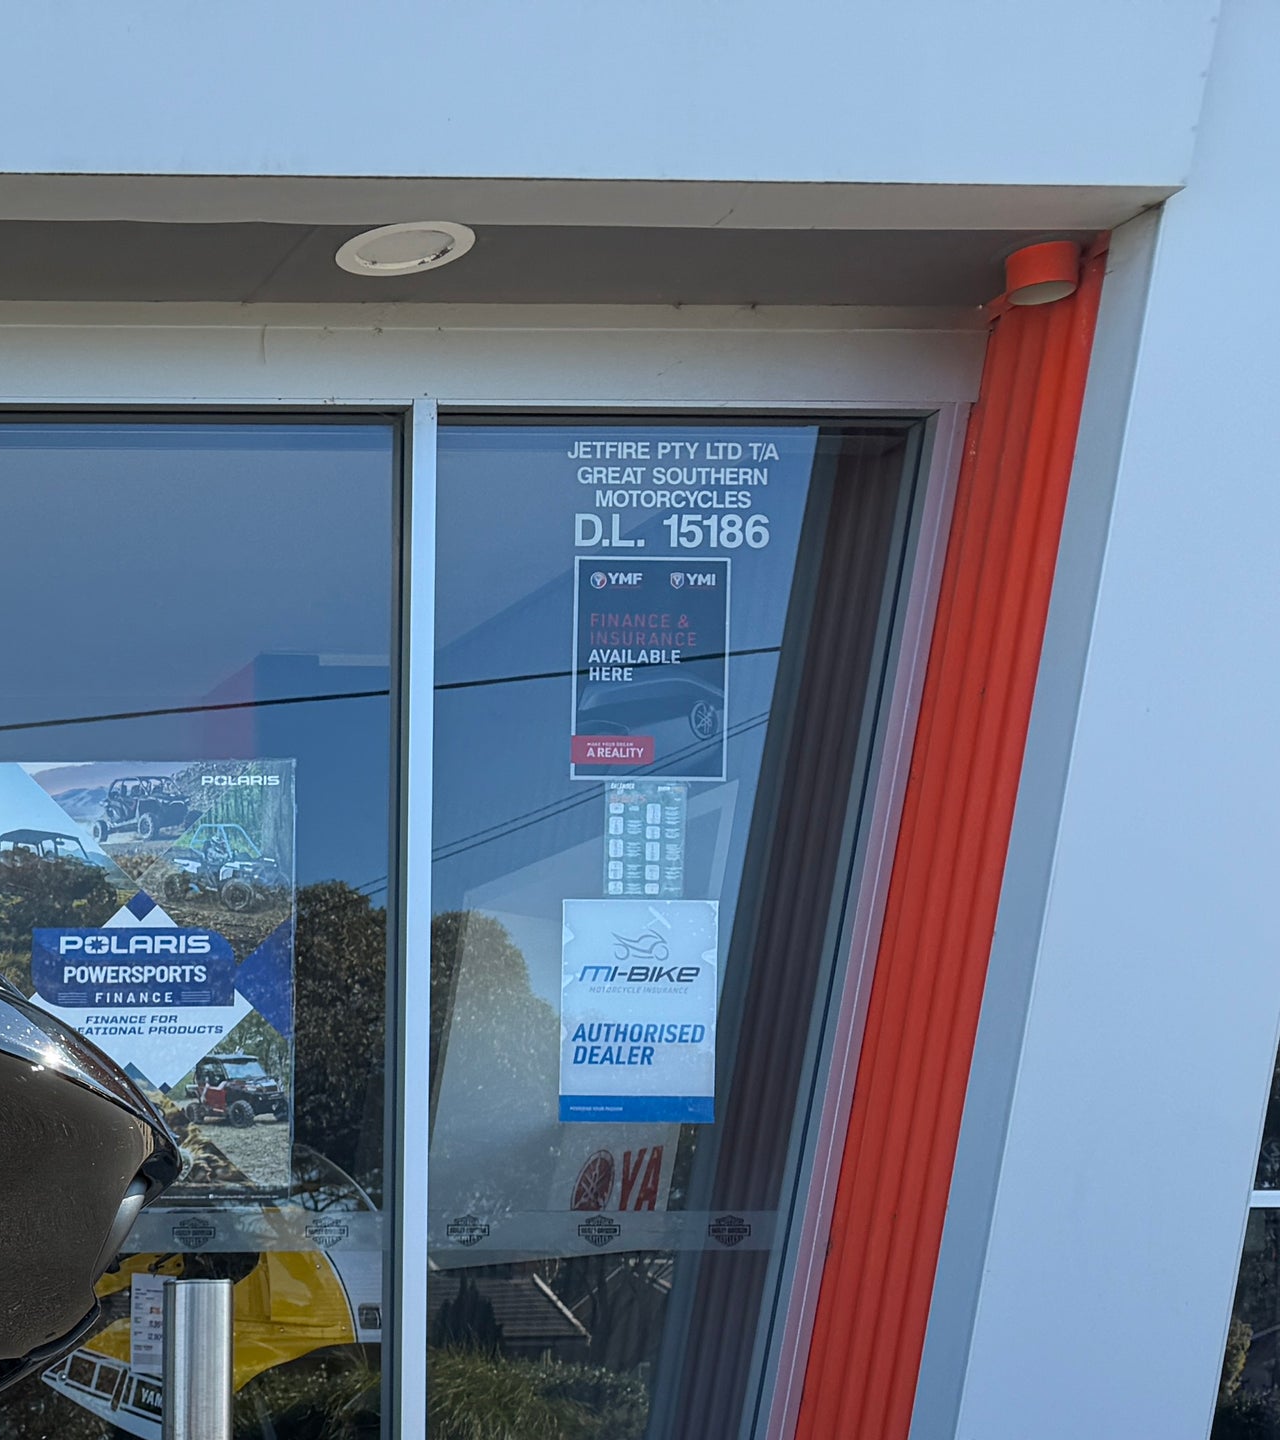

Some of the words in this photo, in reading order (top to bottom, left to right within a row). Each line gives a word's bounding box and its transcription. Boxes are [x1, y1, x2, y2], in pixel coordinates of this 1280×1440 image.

[567, 441, 650, 460] JETFIRE
[657, 442, 699, 460] PTY
[705, 442, 742, 460] LTD
[748, 443, 780, 463] T/A
[577, 467, 646, 484] GREAT
[652, 467, 768, 486] SOUTHERN
[595, 490, 752, 509] MOTORCYCLES
[574, 513, 645, 548] D.L.
[663, 514, 770, 549] 15186
[607, 572, 643, 585] YMF
[686, 573, 716, 586] YMI
[590, 613, 671, 629] FINANCE
[678, 614, 689, 629] &
[590, 632, 697, 647] INSURANCE
[588, 649, 681, 664] AVAILABLE
[589, 667, 633, 681] HERE
[586, 747, 595, 758] A
[597, 747, 644, 758] REALITY
[201, 775, 280, 786] POLARIS
[59, 935, 211, 954] POLARIS
[63, 965, 207, 984] POWERSPORTS
[95, 991, 173, 1003] FINANCE
[85, 1015, 147, 1024] FINANCE
[150, 1015, 178, 1024] FOR
[148, 1025, 223, 1035] PRODUCTS
[571, 1023, 706, 1043] AUTHORISED
[572, 1046, 655, 1065] DEALER
